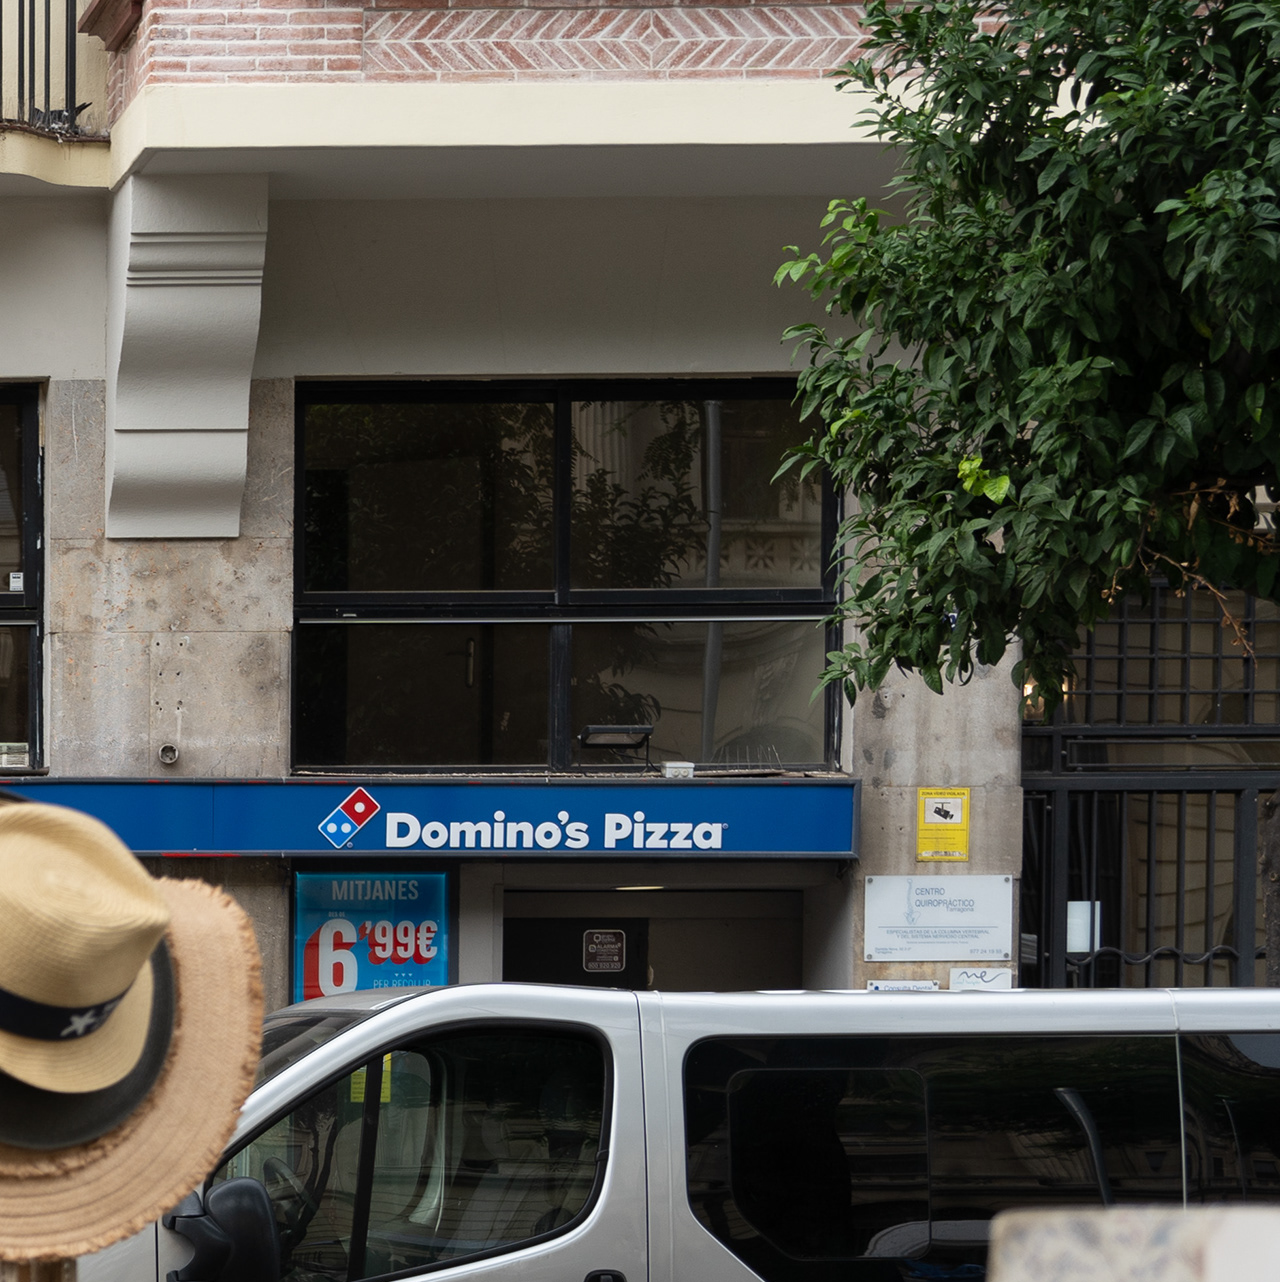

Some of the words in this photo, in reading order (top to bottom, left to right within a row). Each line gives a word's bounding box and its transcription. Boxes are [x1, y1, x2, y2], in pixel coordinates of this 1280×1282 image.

[385, 810, 590, 849] Domino's
[604, 811, 723, 850] Pizza
[332, 880, 419, 900] MITJANES
[914, 887, 945, 896] CENTRO
[946, 905, 975, 913] Tarragona
